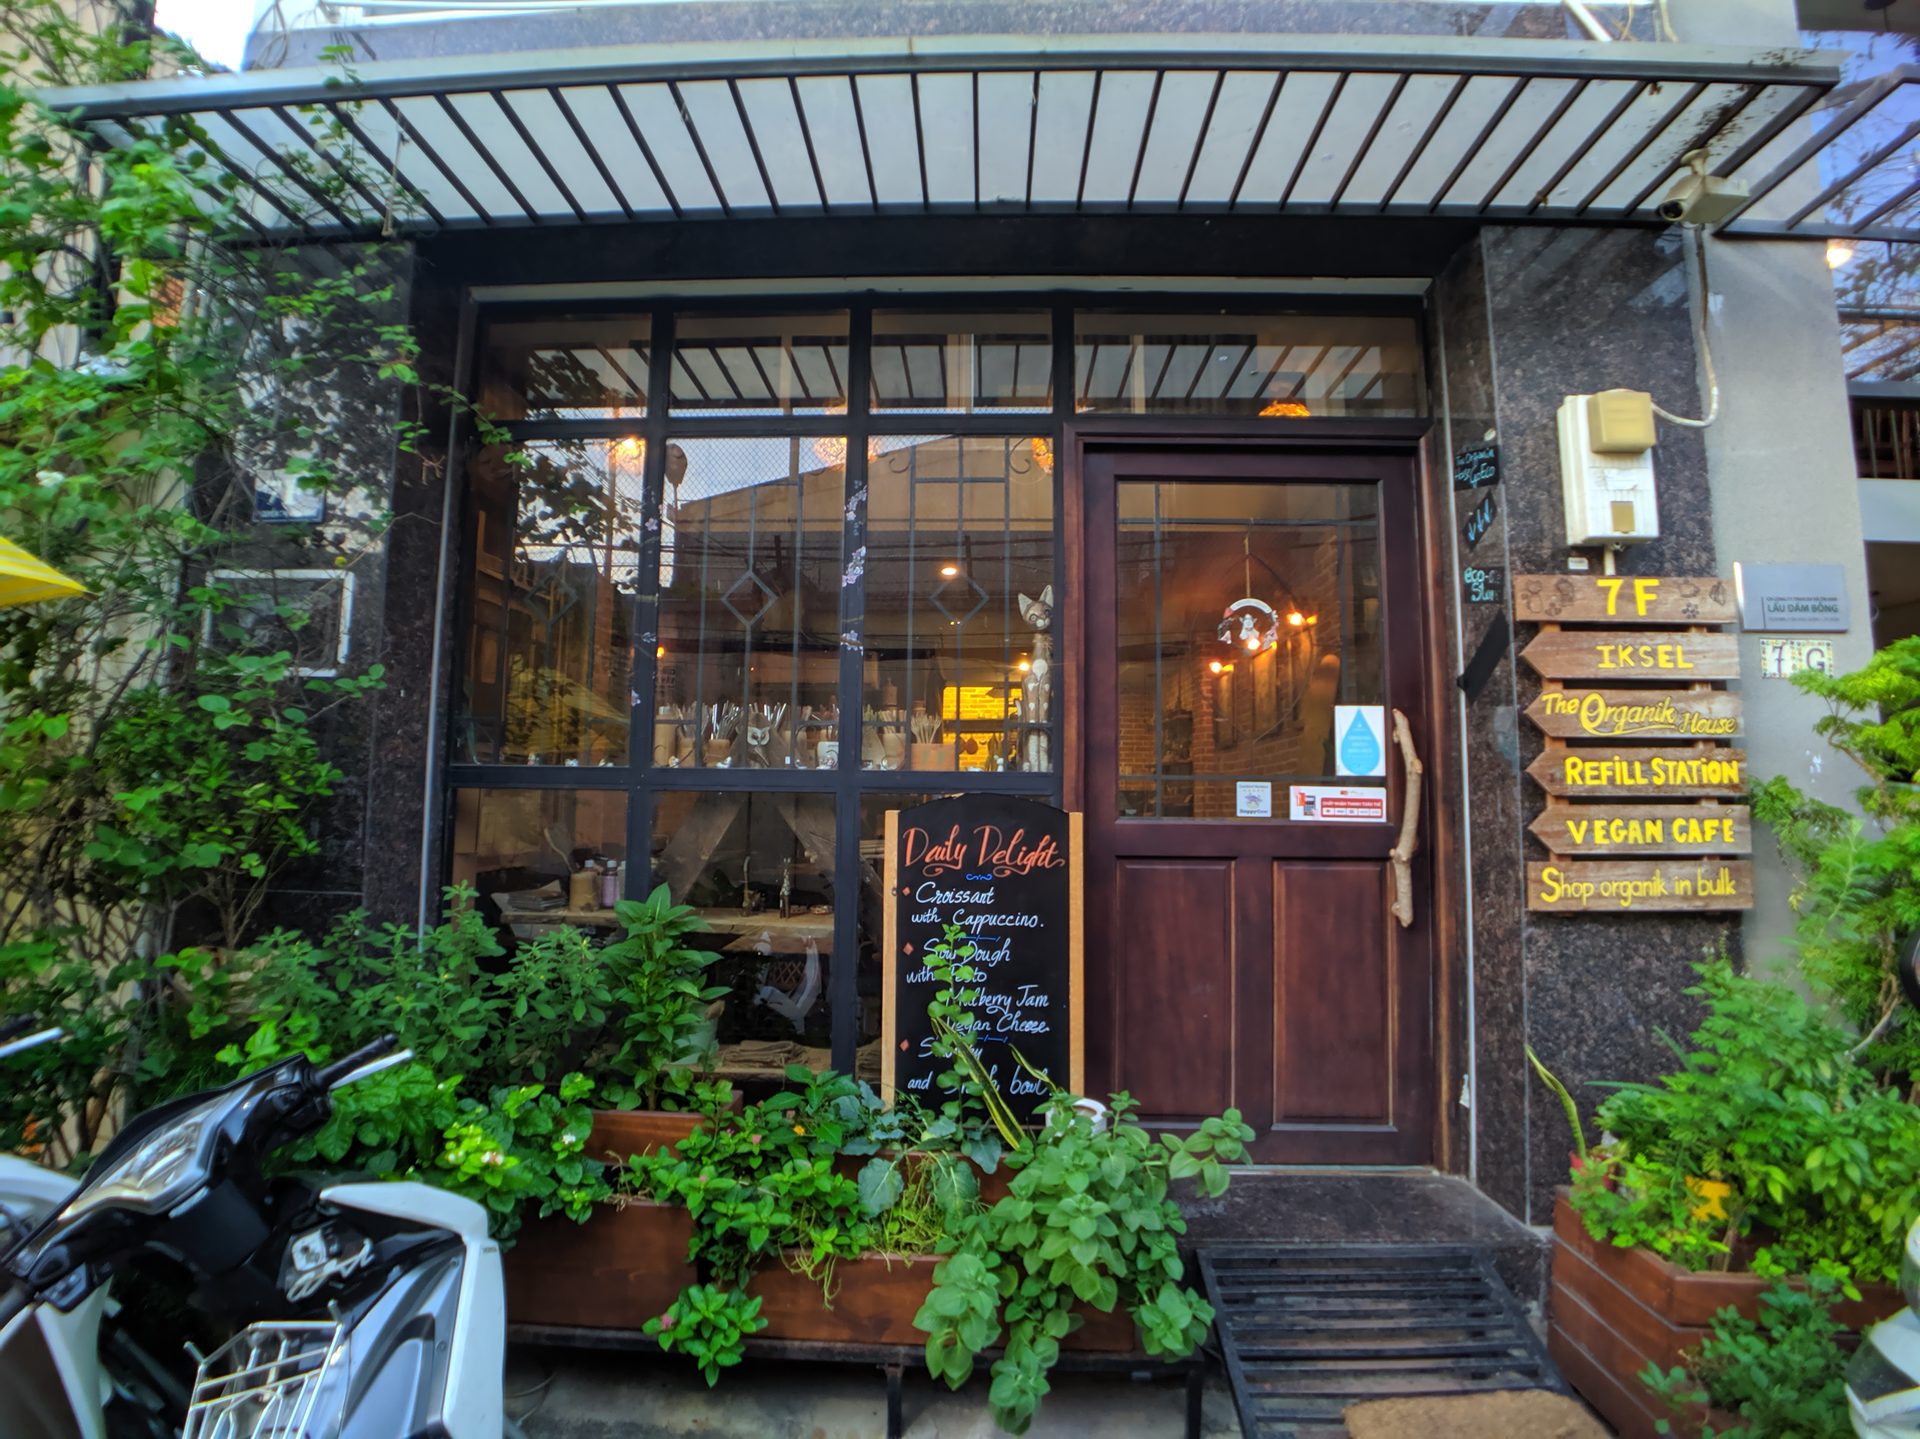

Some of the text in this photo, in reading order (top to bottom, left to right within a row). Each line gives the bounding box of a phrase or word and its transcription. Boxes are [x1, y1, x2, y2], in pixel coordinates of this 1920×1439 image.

[1597, 579, 1660, 616] 7F
[1595, 644, 1694, 669] IKSEL
[1541, 691, 1737, 736] The Organik House
[1566, 818, 1664, 845] VEGAN
[902, 824, 1066, 878] Daily Delight
[915, 881, 995, 905] Croissant
[1540, 866, 1737, 907] Shop organik in bulk
[911, 907, 942, 924] with
[960, 938, 1011, 968] Dough
[906, 966, 936, 984] with
[1016, 984, 1050, 1008] Jam
[907, 1070, 934, 1090] and
